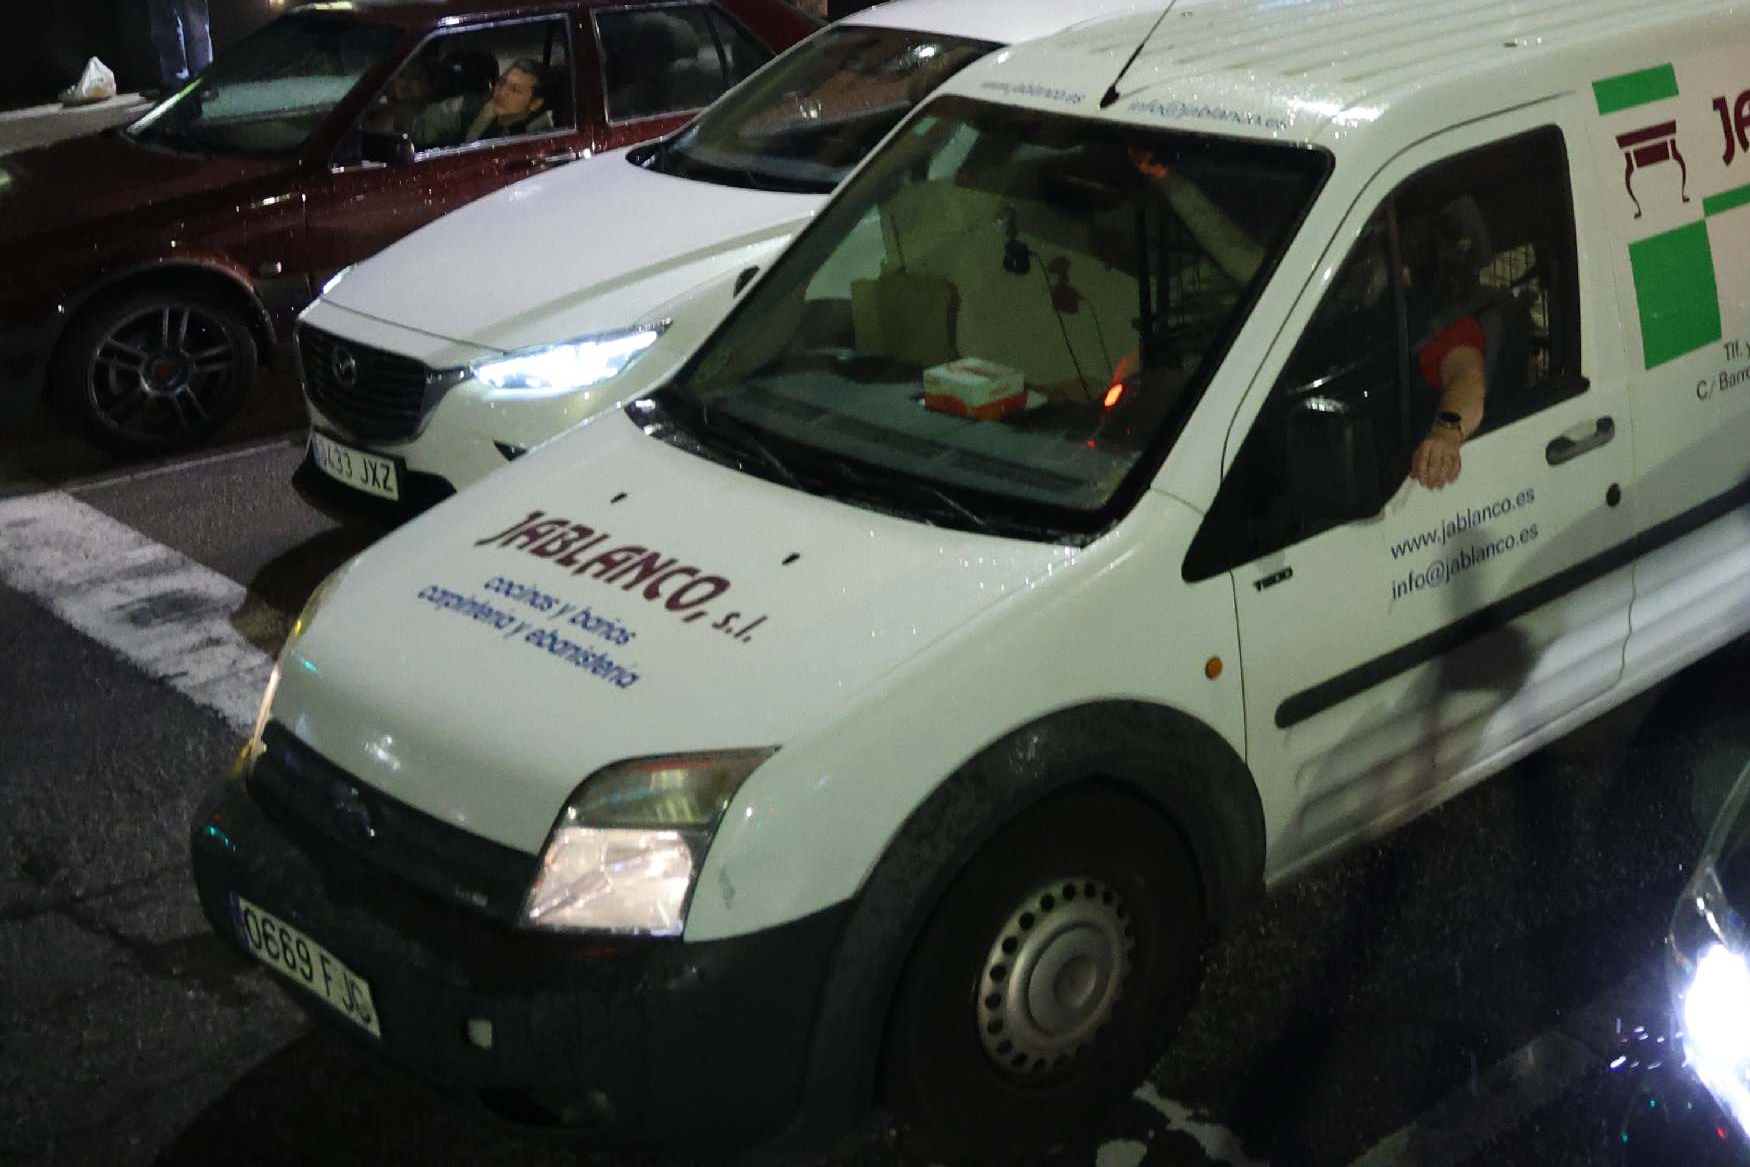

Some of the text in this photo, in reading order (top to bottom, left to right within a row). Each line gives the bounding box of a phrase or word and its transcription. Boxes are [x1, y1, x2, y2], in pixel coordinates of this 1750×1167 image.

[361, 456, 394, 492] JXZ
[1391, 487, 1535, 560] www.jablanco.es
[1391, 522, 1540, 601] info@jablanco.es
[484, 576, 559, 611] cocinas
[548, 602, 577, 620] y
[503, 621, 533, 640] y
[711, 611, 768, 643] s.l.
